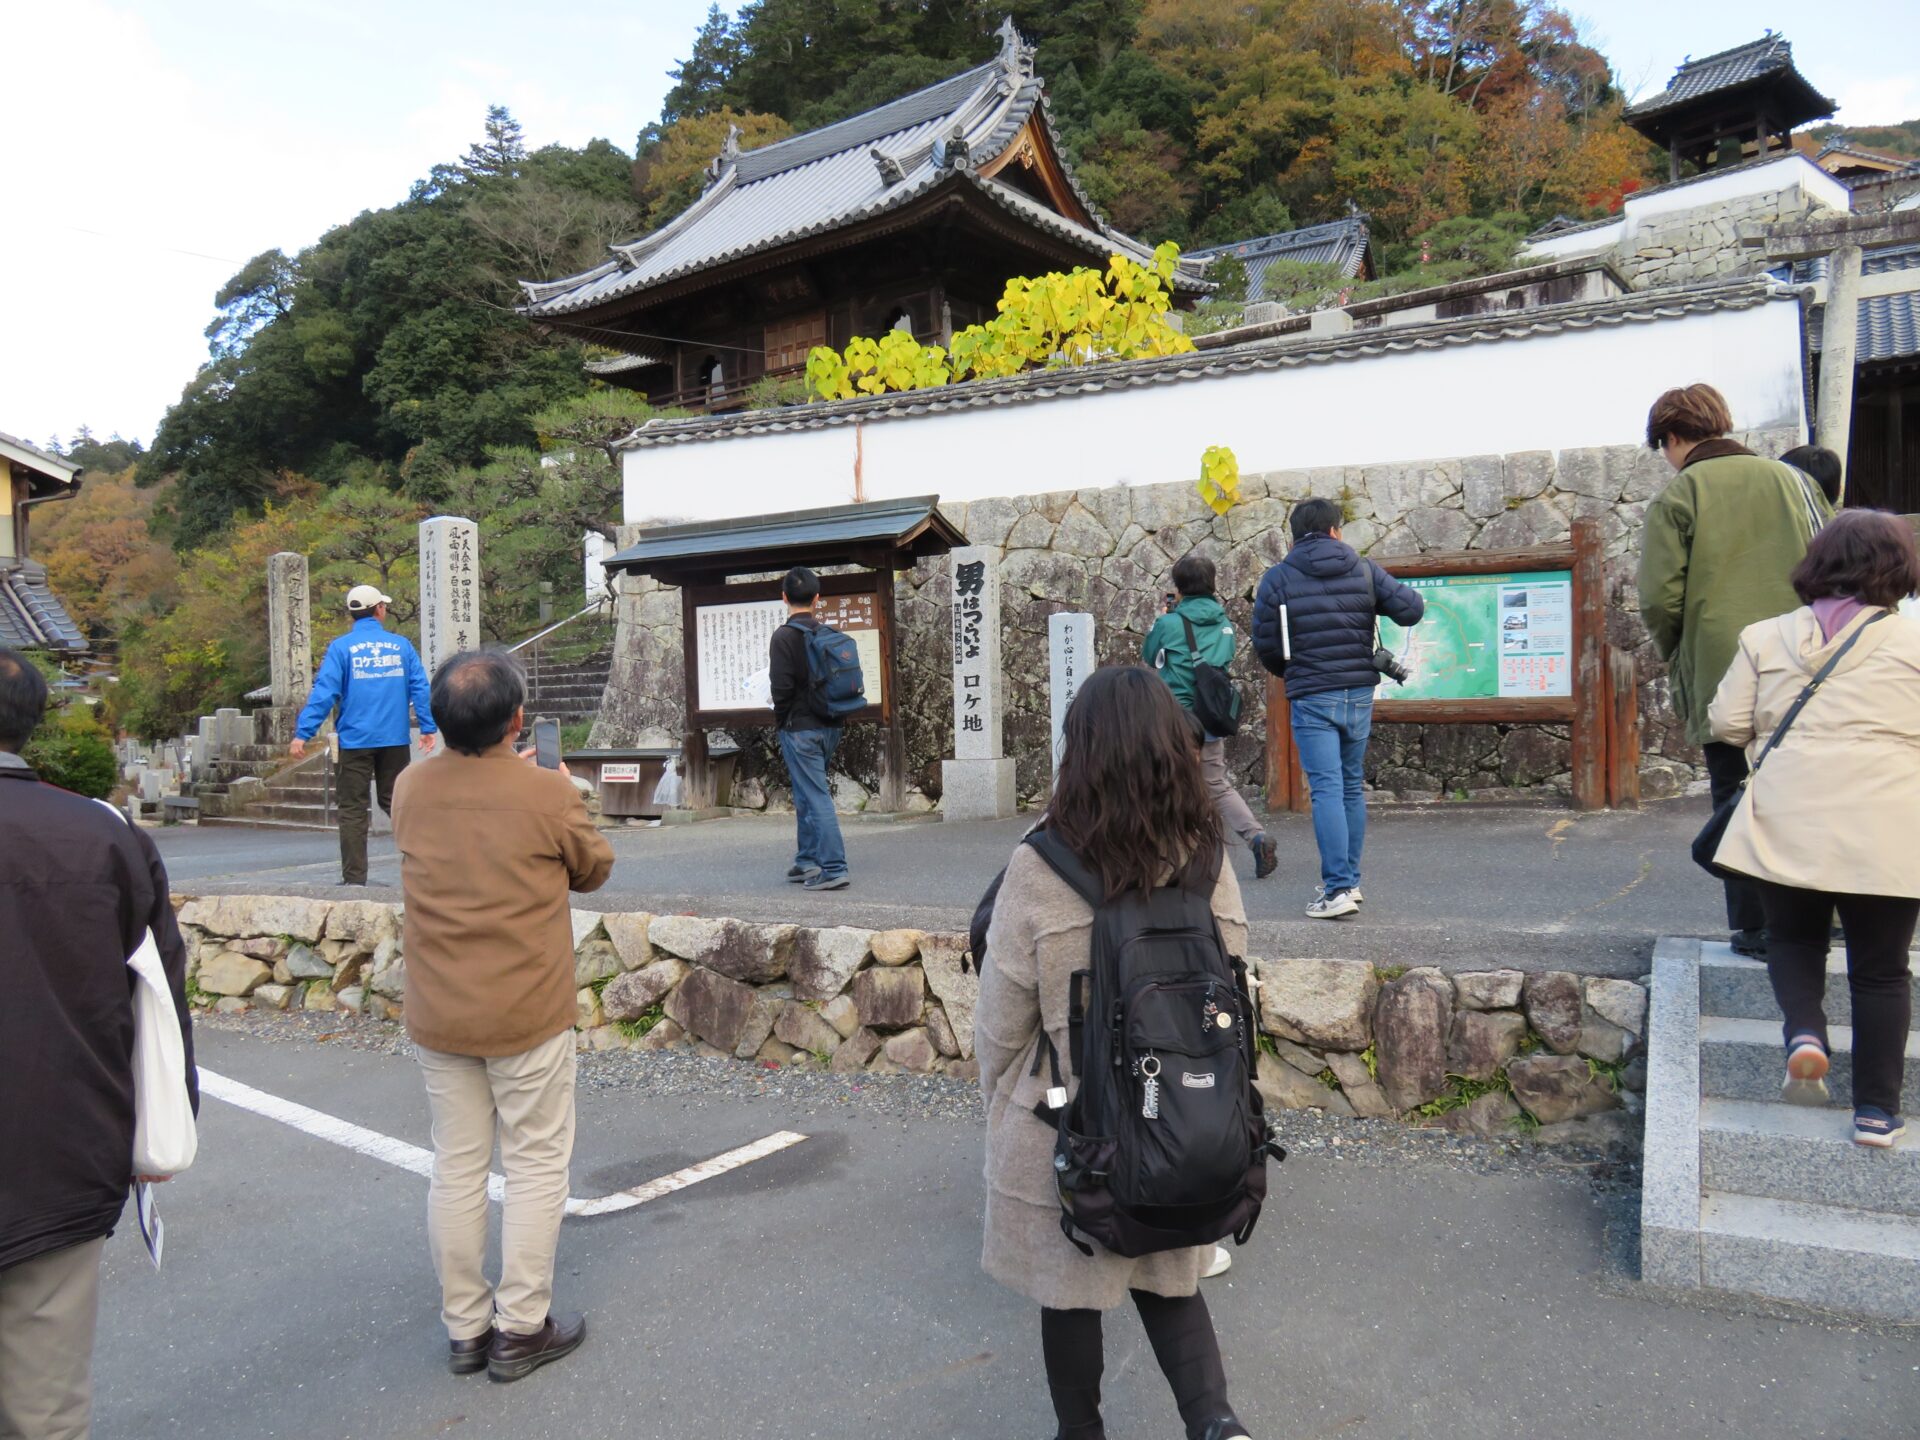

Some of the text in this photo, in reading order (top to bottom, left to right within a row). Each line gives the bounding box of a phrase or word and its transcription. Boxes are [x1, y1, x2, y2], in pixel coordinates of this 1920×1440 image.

[955, 560, 985, 732] 男はつらいよ ロケ地
